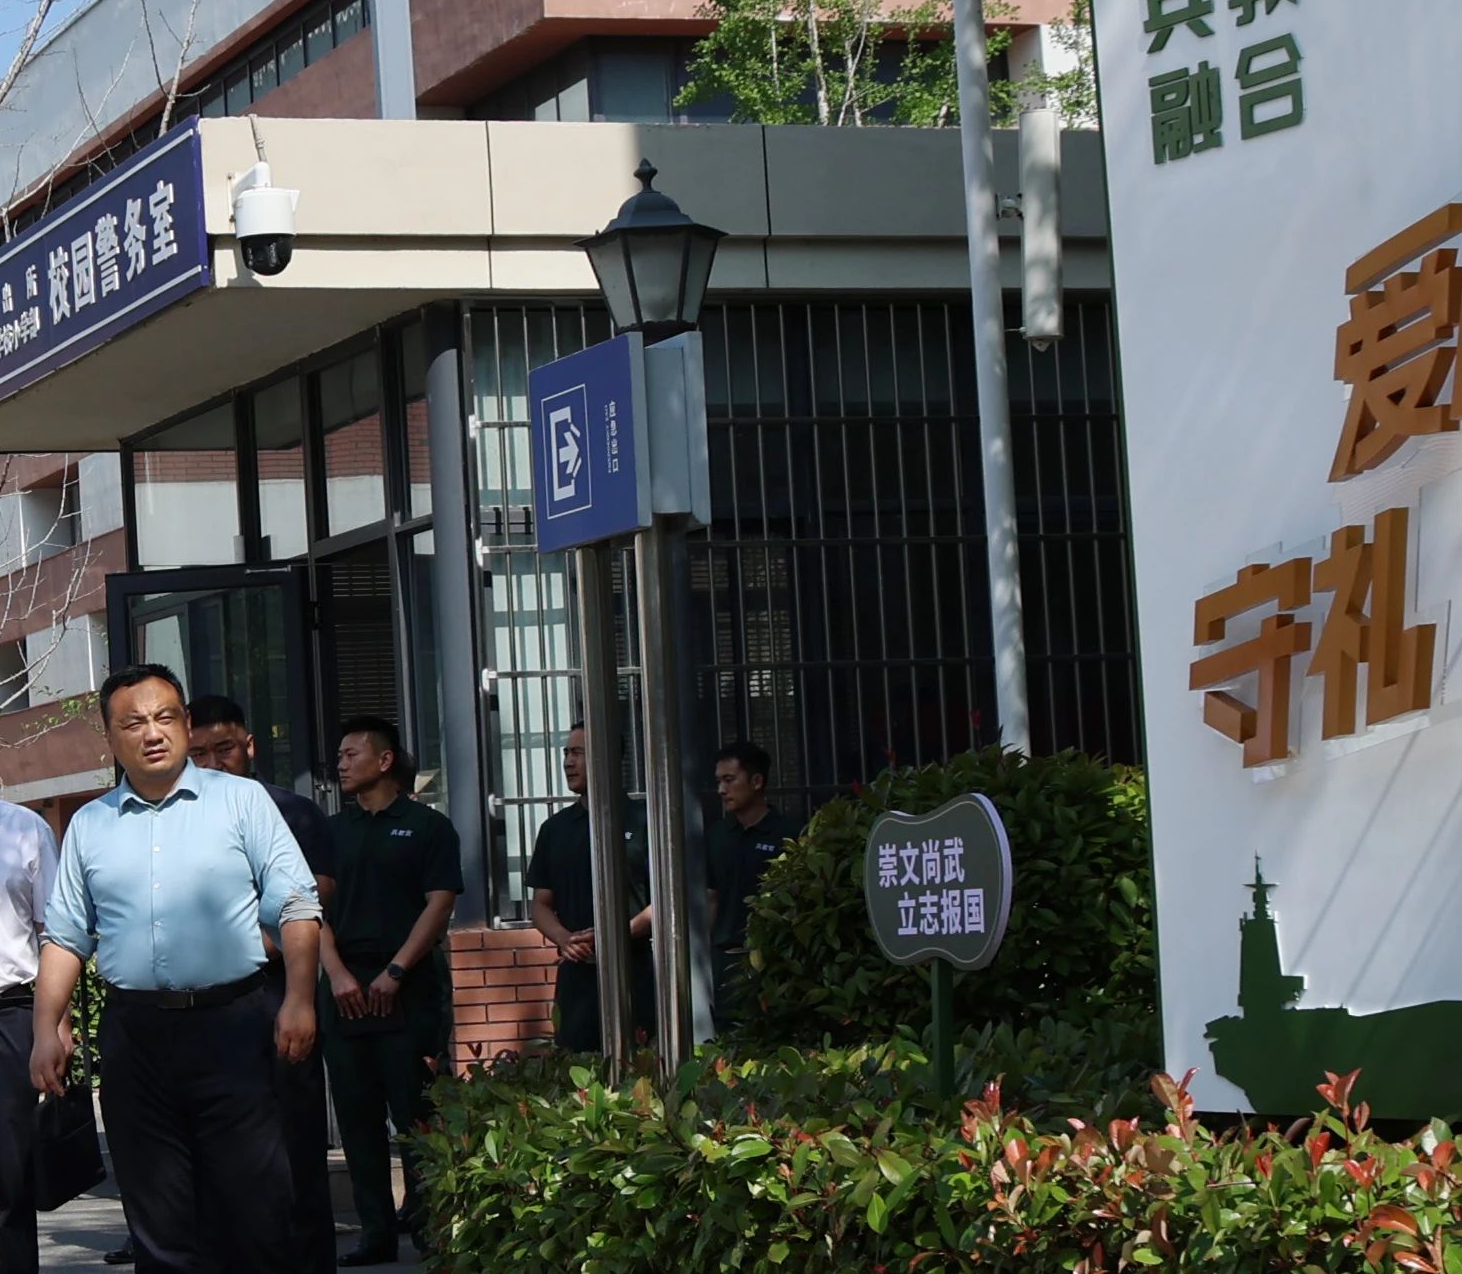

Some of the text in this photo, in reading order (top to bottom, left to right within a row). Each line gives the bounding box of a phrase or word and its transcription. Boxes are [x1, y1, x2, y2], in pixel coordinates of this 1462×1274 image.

[1149, 33, 1304, 165] 融合
[48, 180, 178, 325] 校园警务室
[1189, 507, 1436, 768] 守礼
[878, 836, 965, 888] 崇文尚武
[897, 888, 985, 935] 立志报国
